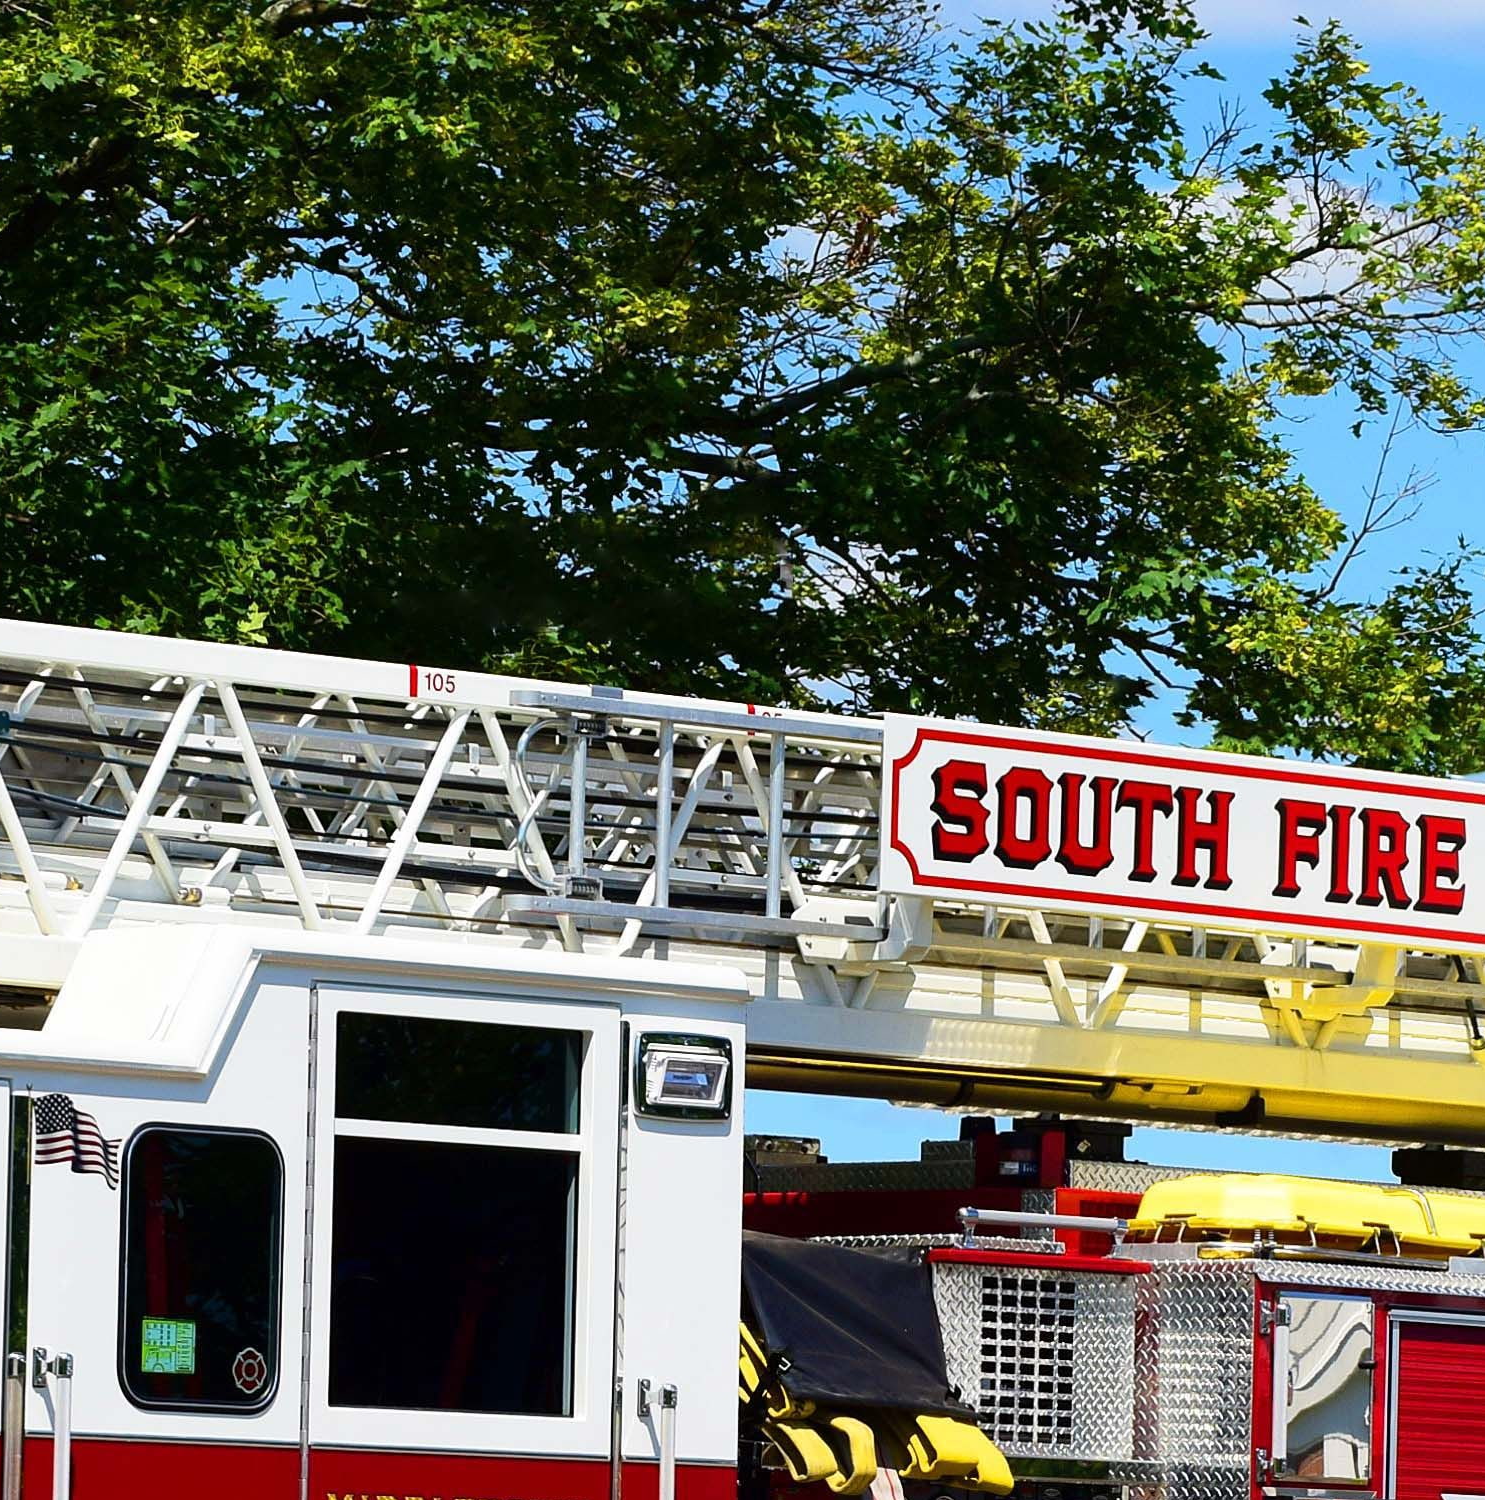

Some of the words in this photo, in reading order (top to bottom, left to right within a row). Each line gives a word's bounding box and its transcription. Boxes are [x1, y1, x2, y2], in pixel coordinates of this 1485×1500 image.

[424, 672, 456, 693] 105
[930, 758, 1236, 890] SOUTH
[1272, 798, 1467, 916] FIRE
